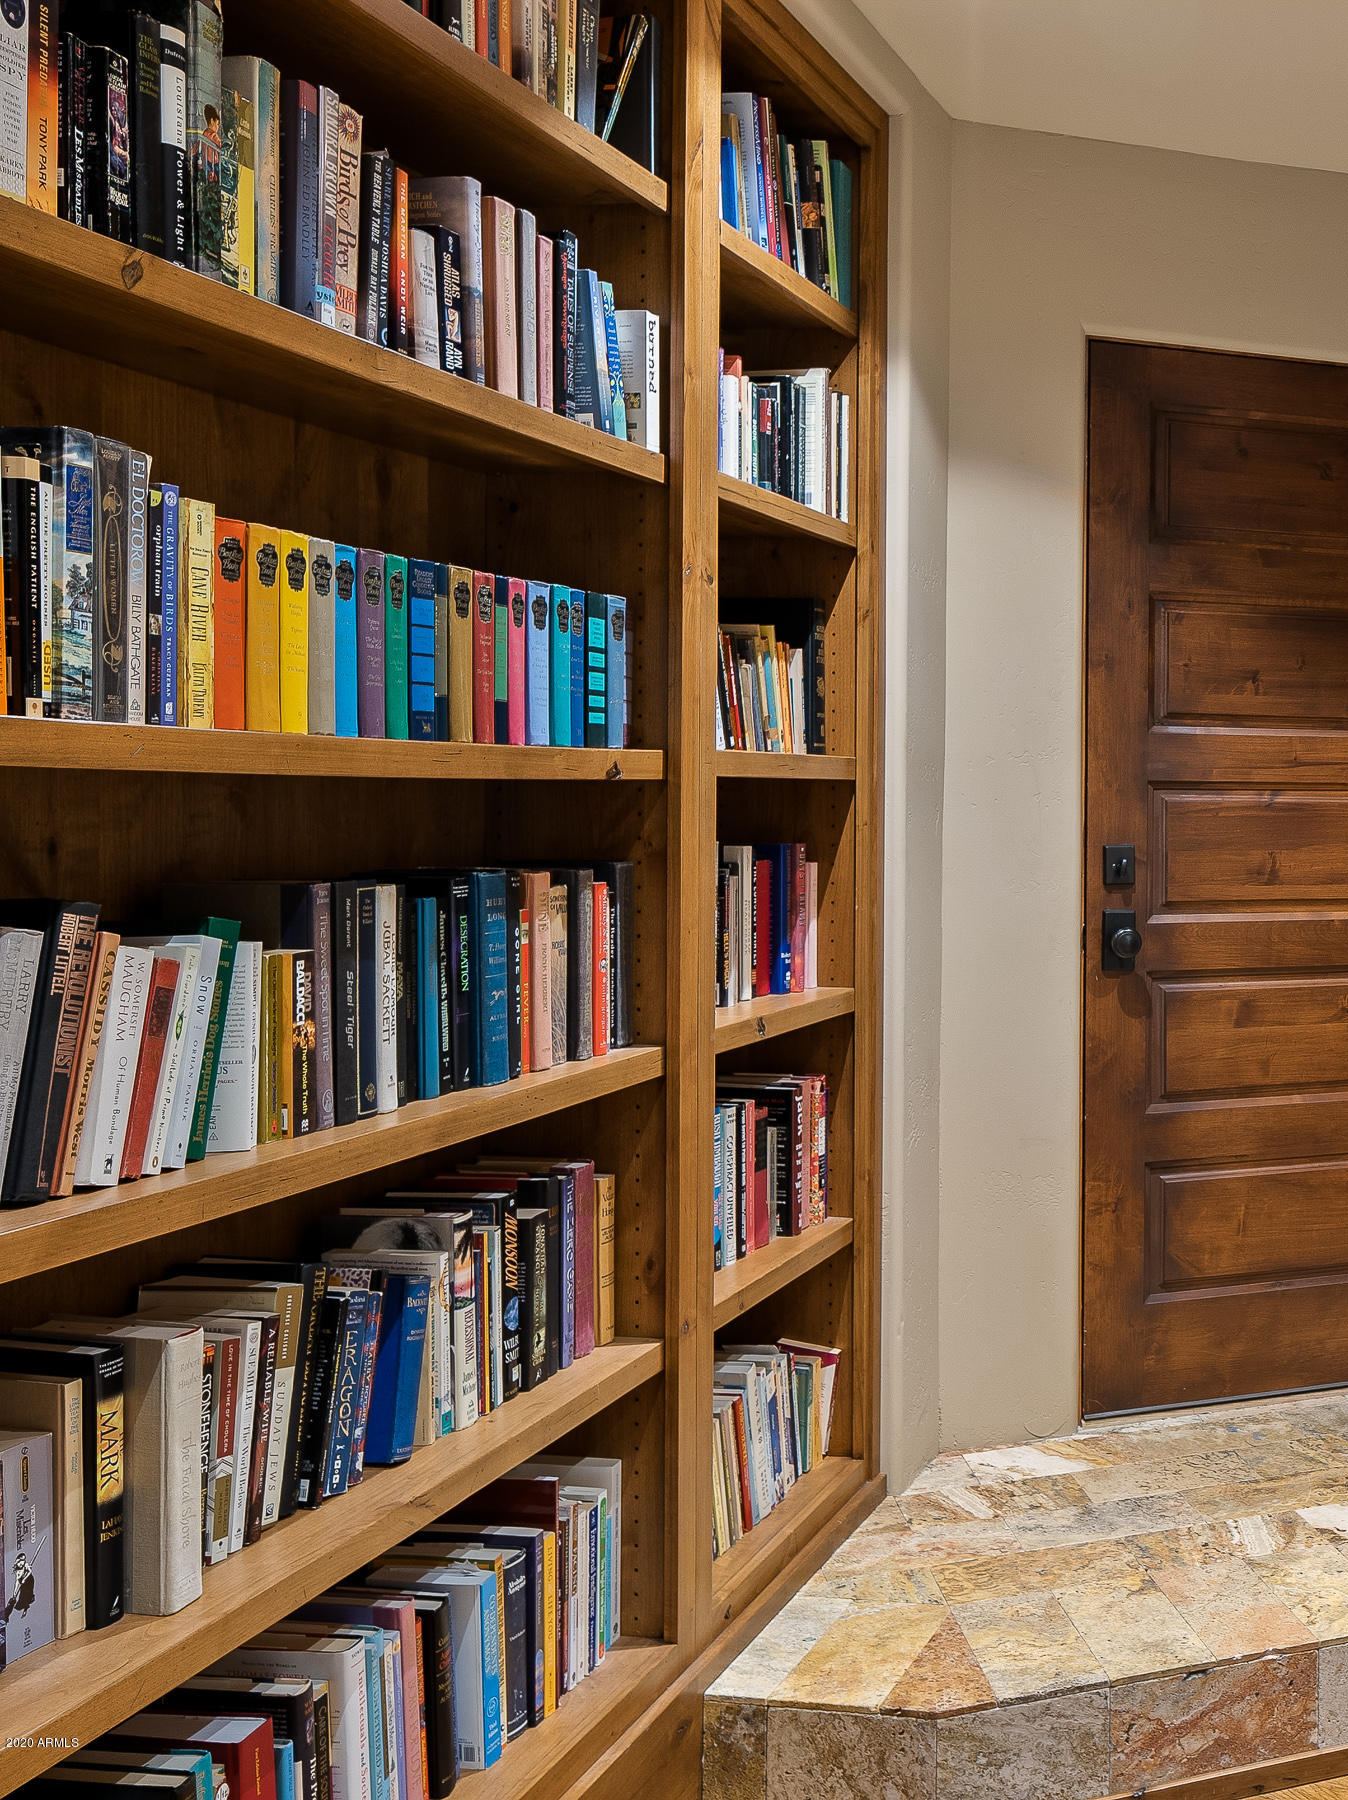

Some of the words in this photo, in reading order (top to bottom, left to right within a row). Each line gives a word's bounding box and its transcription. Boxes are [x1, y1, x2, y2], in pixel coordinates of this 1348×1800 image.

[39, 5, 49, 50] SILENT
[0, 63, 26, 82] SPY
[38, 118, 48, 149] TONY
[38, 151, 47, 191] PARK
[176, 152, 185, 194] Power
[324, 164, 336, 219] BROWN
[337, 146, 359, 200] Birds
[383, 167, 392, 201] SPARE
[176, 200, 185, 209] &
[372, 175, 382, 212] HEAVENLY
[175, 213, 185, 251] Light
[336, 225, 357, 275] Prey
[371, 217, 380, 243] TABLE
[381, 241, 389, 282] JOSHUA
[443, 252, 453, 306] SHRUGGED
[379, 286, 387, 318] DAVIS
[451, 268, 461, 299] ATLAS
[368, 291, 377, 326] POLLOCK
[567, 315, 574, 331] OF
[445, 341, 455, 370] RAND
[453, 348, 462, 369] AYN
[648, 320, 657, 394] burned
[129, 482, 147, 590] DOCTOROW
[153, 524, 163, 567] orphan
[165, 527, 175, 579] GRAVITY
[154, 569, 163, 597] train
[191, 567, 209, 598] CANE
[132, 594, 141, 622] BILLY
[165, 593, 174, 632] BIRDS
[191, 604, 210, 643] RIVER
[43, 644, 51, 686] USED
[130, 626, 141, 690] BATHGATE
[78, 915, 99, 947] THE
[319, 912, 328, 936] The
[440, 910, 448, 952] James
[320, 939, 329, 981] Sweet
[383, 921, 391, 969] JUBAL
[459, 915, 468, 991] DESECRATION
[16, 958, 35, 1015] LARRY
[50, 954, 66, 996] LITTELL
[196, 975, 212, 1015] Snow
[296, 960, 305, 1025] BALDACCI
[304, 971, 312, 1012] DAVID
[346, 970, 354, 1006] Steel
[54, 947, 88, 1079] REVOLUTIONIST
[91, 950, 116, 1049] CASSIDY
[116, 954, 135, 1042] MAUGHAM
[129, 979, 142, 1038] SOMERSET
[209, 980, 224, 1021] Stories
[382, 974, 391, 1045] SACKETT
[207, 1022, 220, 1043] Dog
[345, 1015, 355, 1049] Tiger
[187, 1039, 199, 1079] ORHAN
[78, 1057, 95, 1117] Morris
[113, 1074, 125, 1106] Human
[181, 1084, 192, 1121] PAMUK
[70, 1118, 85, 1159] West
[108, 1108, 121, 1145] Bondage
[726, 1135, 734, 1193] CONSPIRACY
[726, 1196, 734, 1240] UNVEILED
[504, 1212, 518, 1290] MONSOON
[566, 1265, 574, 1314] GAME
[268, 1328, 276, 1338] A
[465, 1309, 475, 1364] RECESSIONAL
[247, 1347, 256, 1367] SUE
[263, 1342, 275, 1405] RELIABLE
[244, 1369, 255, 1410] MILLER
[336, 1330, 359, 1438] ERAGON
[259, 1408, 271, 1444] WIFE
[272, 1381, 286, 1445] SUNDAY
[101, 1408, 119, 1490] MARK
[222, 1420, 230, 1453] CHOLERA
[240, 1424, 250, 1444] The
[238, 1446, 248, 1476] World
[267, 1453, 278, 1492] JEWS
[236, 1478, 246, 1509] Below
[358, 1670, 366, 1750] Intellectuals
